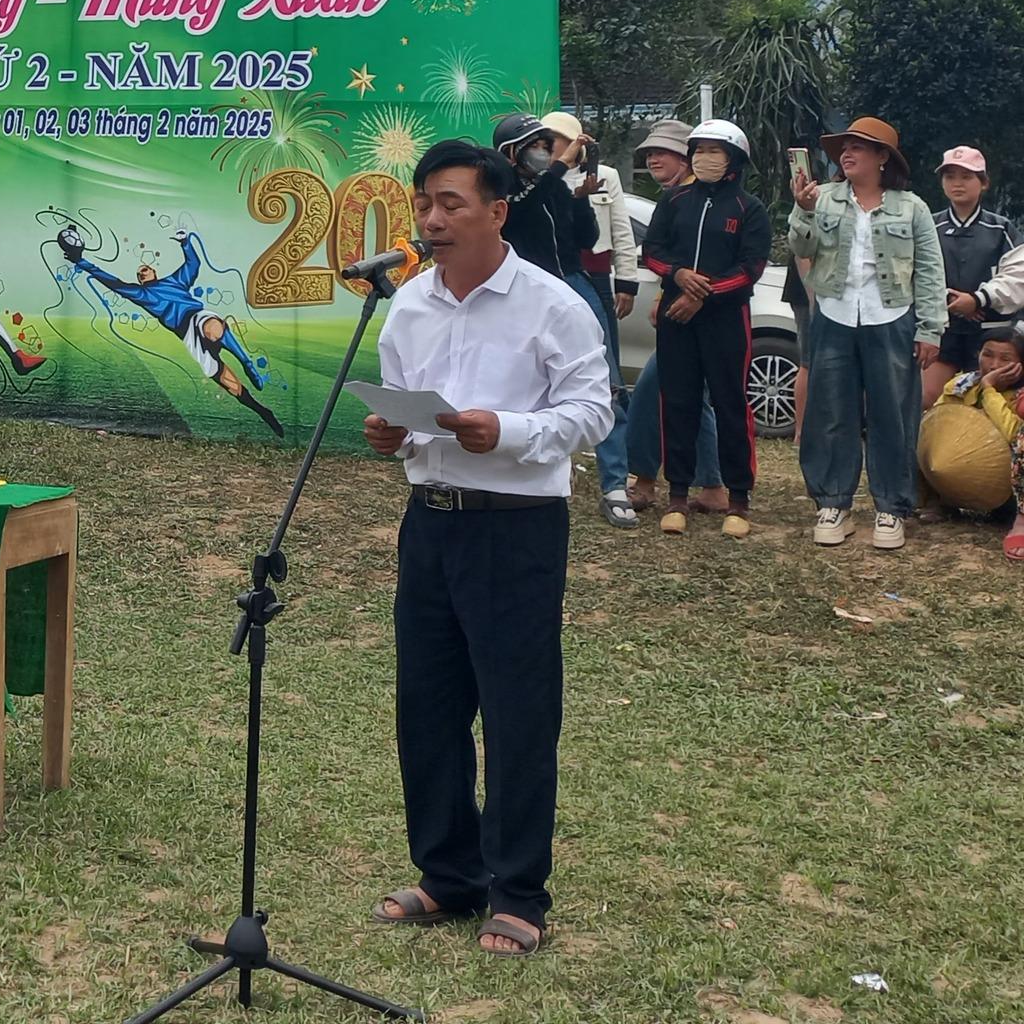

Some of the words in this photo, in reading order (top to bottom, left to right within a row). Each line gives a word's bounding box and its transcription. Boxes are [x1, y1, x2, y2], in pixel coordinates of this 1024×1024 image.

[26, 54, 49, 91] 2
[84, 42, 203, 91] NĂM
[210, 51, 311, 91] 2025
[3, 109, 29, 139] 01,
[35, 109, 61, 139] 02,
[67, 109, 89, 136] 03
[96, 106, 151, 144] tháng
[156, 109, 169, 136] 2
[176, 109, 219, 137] năm
[224, 109, 273, 138] 2025
